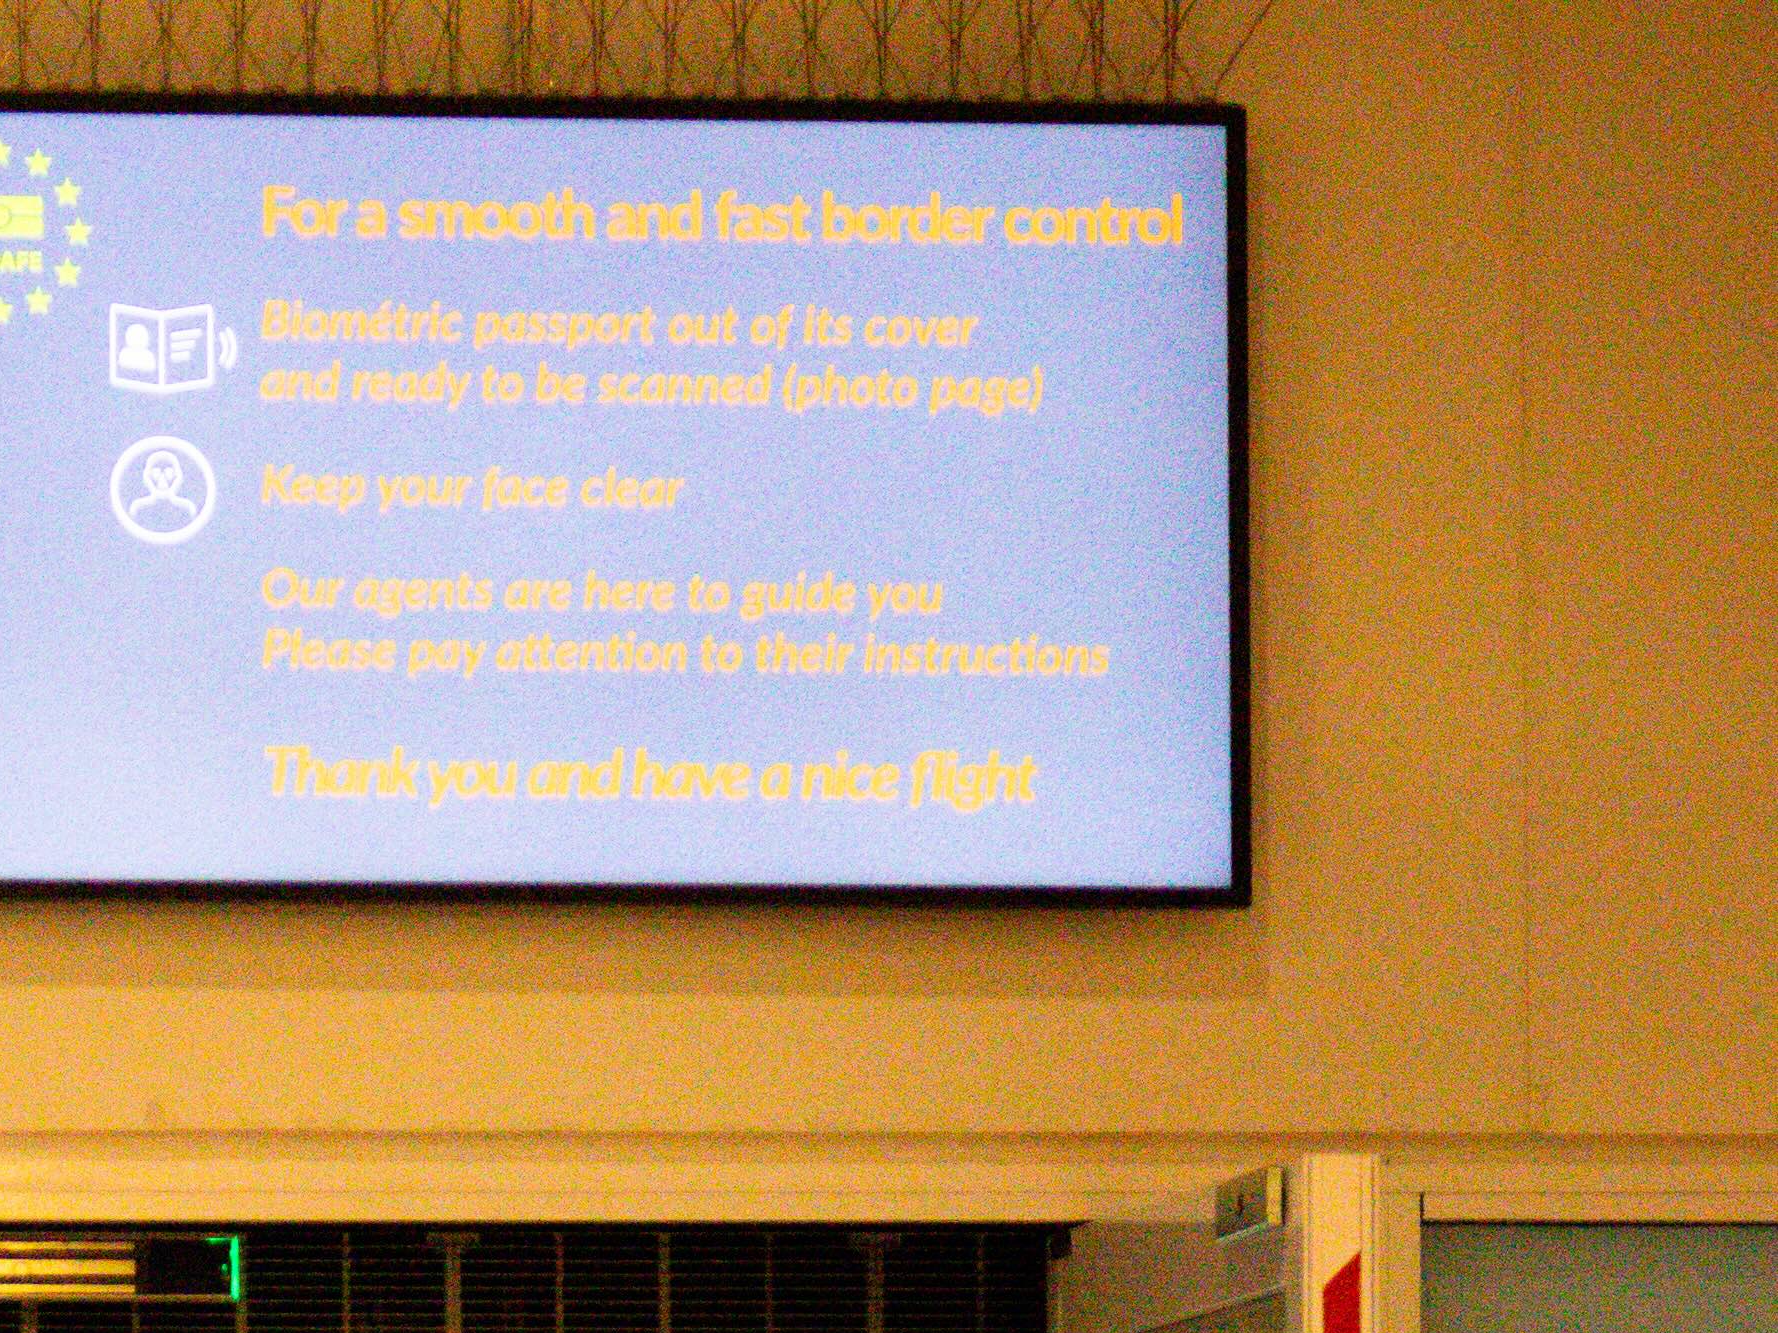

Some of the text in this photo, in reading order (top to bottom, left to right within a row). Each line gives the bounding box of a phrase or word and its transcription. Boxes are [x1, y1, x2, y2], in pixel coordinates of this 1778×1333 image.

[260, 183, 1188, 247] For a smooth and fast border control
[471, 306, 656, 350] passport
[665, 306, 740, 345] out
[747, 303, 794, 350] of
[800, 303, 855, 347] its
[861, 312, 979, 348] cover
[257, 359, 1046, 418] and ready to be scanned (photo page)
[259, 463, 684, 512] Keep your face clear
[259, 565, 946, 621] Our agents are here to guide you
[260, 626, 1112, 678] Please pay attention to their instructions
[265, 743, 1039, 813] Thank you and have a nice flight
